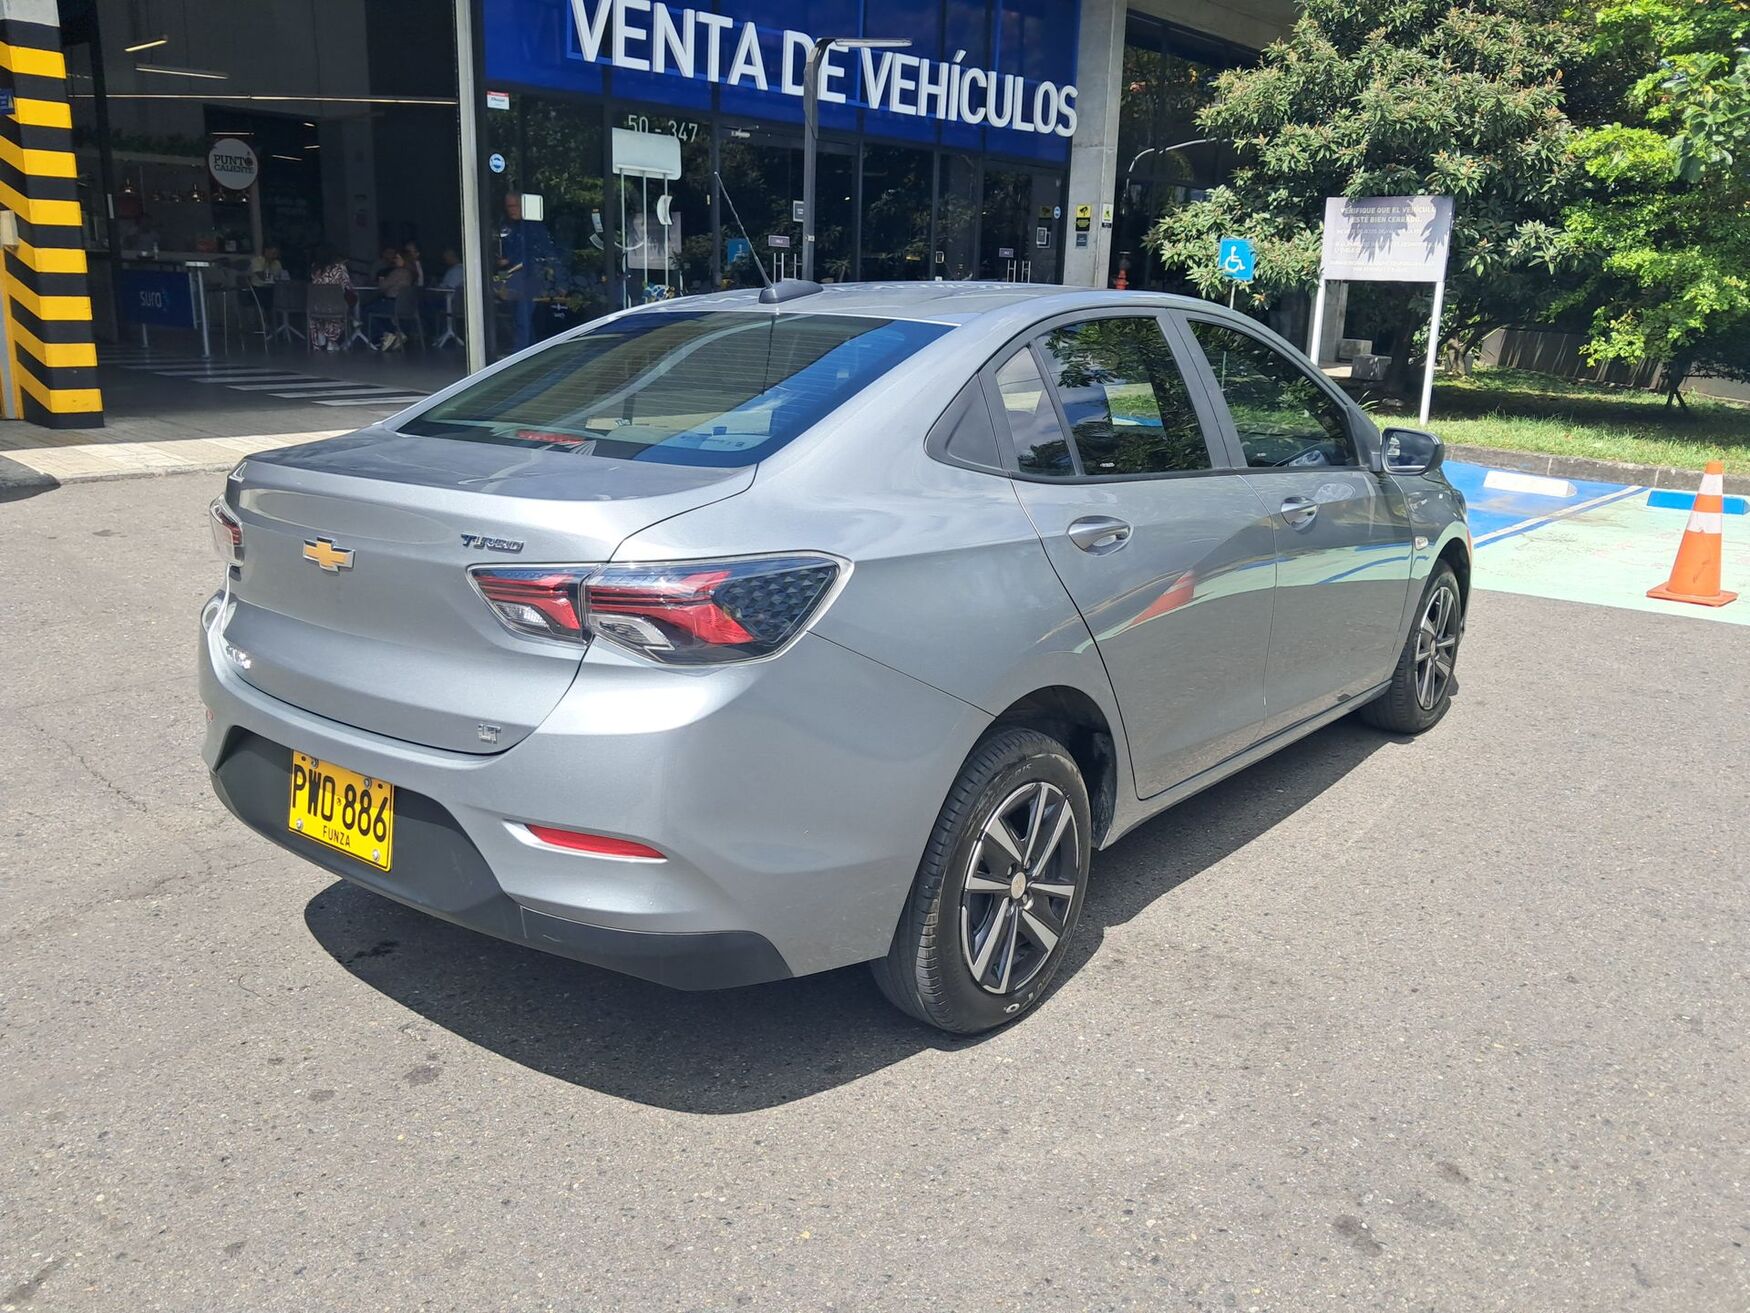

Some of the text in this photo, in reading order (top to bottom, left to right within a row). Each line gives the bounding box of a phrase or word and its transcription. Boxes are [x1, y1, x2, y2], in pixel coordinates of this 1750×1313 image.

[570, 0, 1079, 138] VENTA DE VEHÍCULOS
[628, 114, 649, 134] 50
[667, 120, 698, 143] 347
[214, 153, 254, 168] PUNTO
[1341, 207, 1375, 215] VERIFIQUE
[1376, 207, 1391, 215] QUE
[1392, 207, 1402, 215] EL
[1370, 216, 1387, 225] BIEN
[460, 531, 525, 555] TURBO
[342, 783, 389, 843] 886
[323, 825, 351, 847] FUNZA
